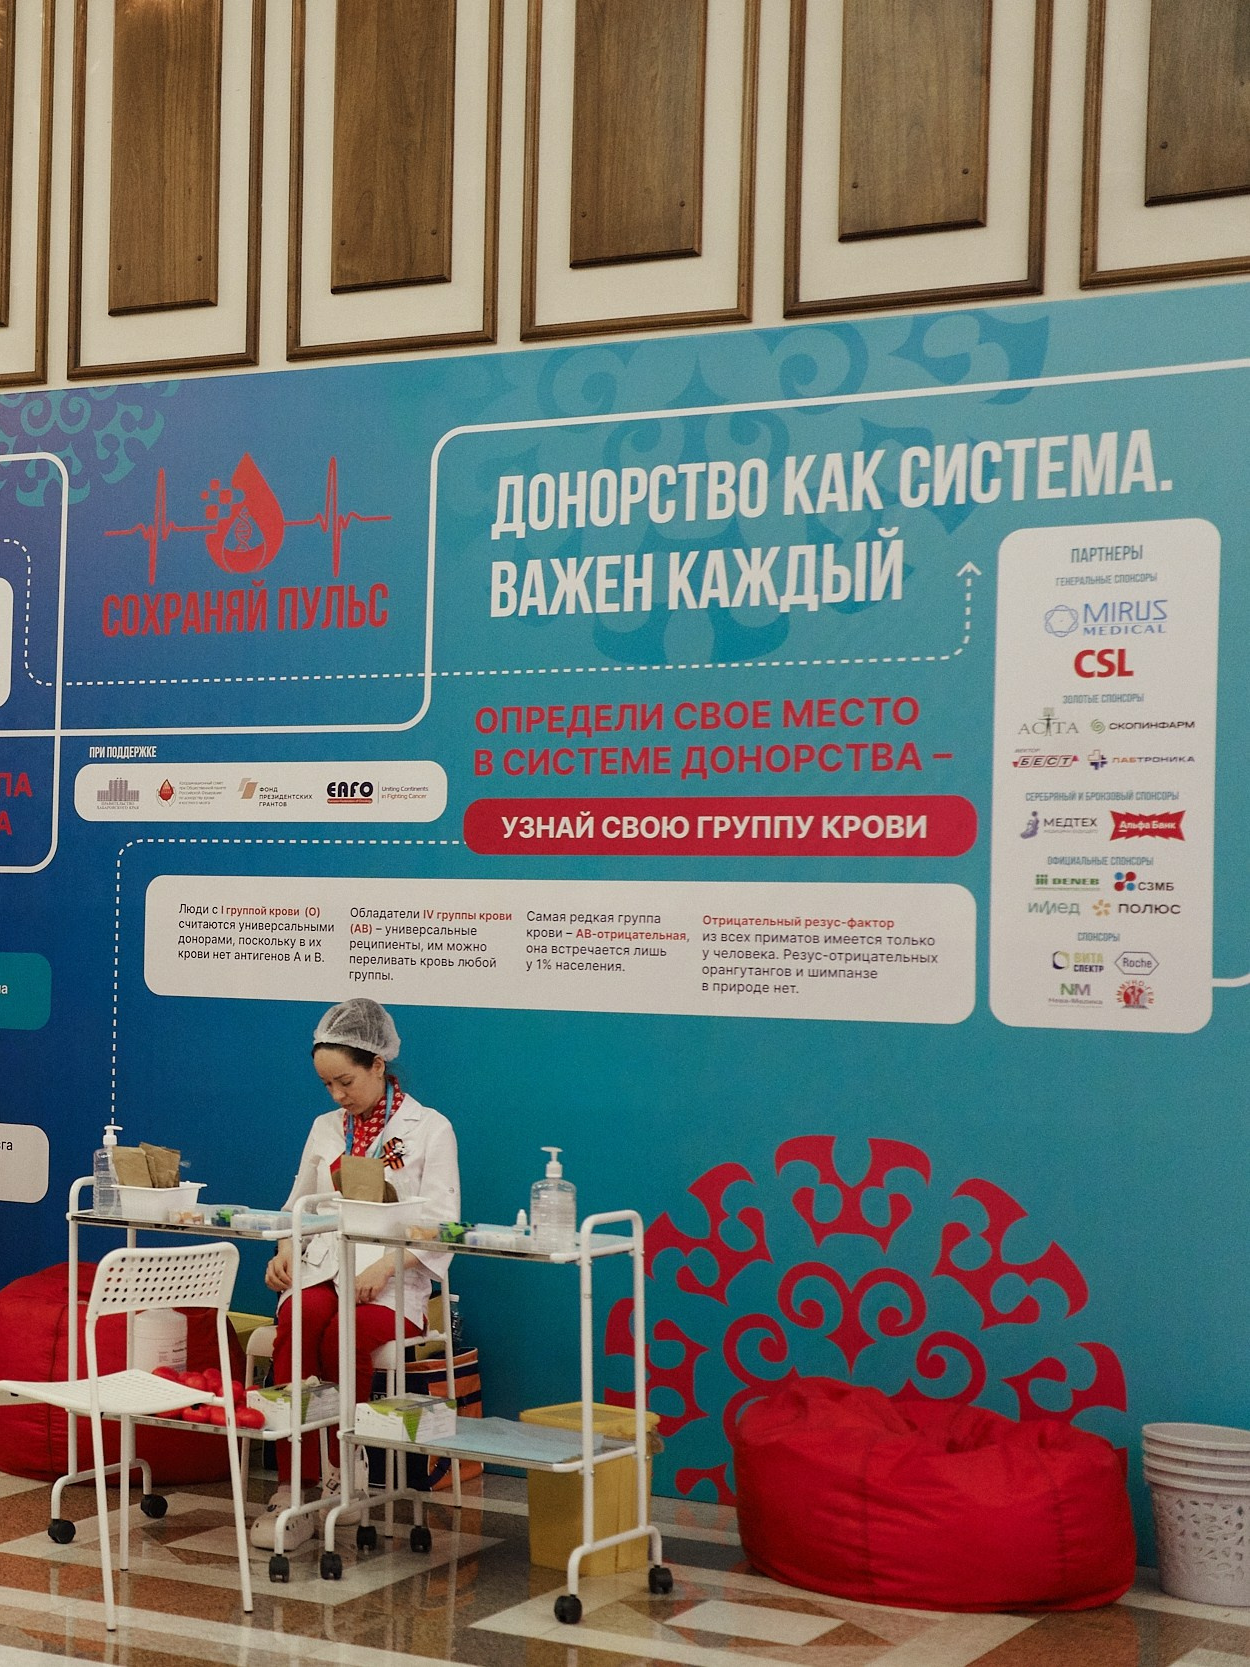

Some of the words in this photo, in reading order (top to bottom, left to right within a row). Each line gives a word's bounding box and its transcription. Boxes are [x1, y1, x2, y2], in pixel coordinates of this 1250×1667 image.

[491, 458, 768, 540] ДОНОРСТВО
[784, 449, 885, 515] КАК
[900, 429, 1172, 508] СИСТЕМА.
[1071, 545, 1143, 563] ПАРТНЕРЫ
[491, 553, 653, 617] ВАЖЕН
[669, 527, 903, 609] КАЖДЫЙ
[1056, 575, 1112, 586] ГЕНЕРАЛЬНЫЕ
[1114, 573, 1157, 583] СПОНСОРЫ
[102, 579, 267, 638] СОХРАНЯЙ
[278, 582, 389, 631] ПУЛЬС
[1084, 600, 1167, 623] MIRUS
[1084, 624, 1165, 635] MEDICAL
[1074, 649, 1133, 678] CSL
[476, 704, 663, 738] ОПРЕДЕЛИ
[674, 701, 771, 730] СВОЕ
[783, 697, 919, 727] МЕСТО
[89, 746, 105, 760] ПРИ
[107, 746, 157, 760] ПОДДЕРЖКЕ
[475, 750, 493, 776] В
[504, 747, 671, 776] СИСТЕМЕ
[681, 744, 922, 779] ДОНОРСТВА
[1019, 756, 1071, 766] БЕСТ
[327, 781, 374, 798] EAFO
[382, 786, 398, 794] Uniting
[400, 785, 429, 793] Continents
[387, 793, 407, 801] Fighting
[502, 811, 594, 838] УЗНАЙ
[602, 816, 689, 838] СВОЮ
[698, 816, 814, 838] ГРУППУ
[822, 815, 926, 838] КРОВИ
[1044, 818, 1097, 828] МЕДТЕХ
[1138, 882, 1174, 891] СЗМБ
[1119, 904, 1180, 914] ПОЛЮС
[703, 915, 801, 927] Отрицательный
[805, 918, 894, 930] резус-фактор
[703, 933, 716, 941] из
[721, 934, 750, 942] всех
[755, 934, 819, 945] приматов
[824, 936, 882, 944] имеется
[887, 937, 935, 946] только
[1078, 932, 1120, 942] СПОНСОРЫ
[702, 950, 709, 960] у
[714, 950, 779, 959] человека.
[784, 949, 938, 963] Резус-отрицательных
[1074, 964, 1104, 973] СПЕКТР
[1123, 957, 1152, 969] Roche
[702, 966, 791, 978] орангутангов
[808, 969, 877, 978] шимпанзе
[702, 983, 708, 991] в
[713, 983, 769, 994] природе
[774, 985, 798, 993] нет.
